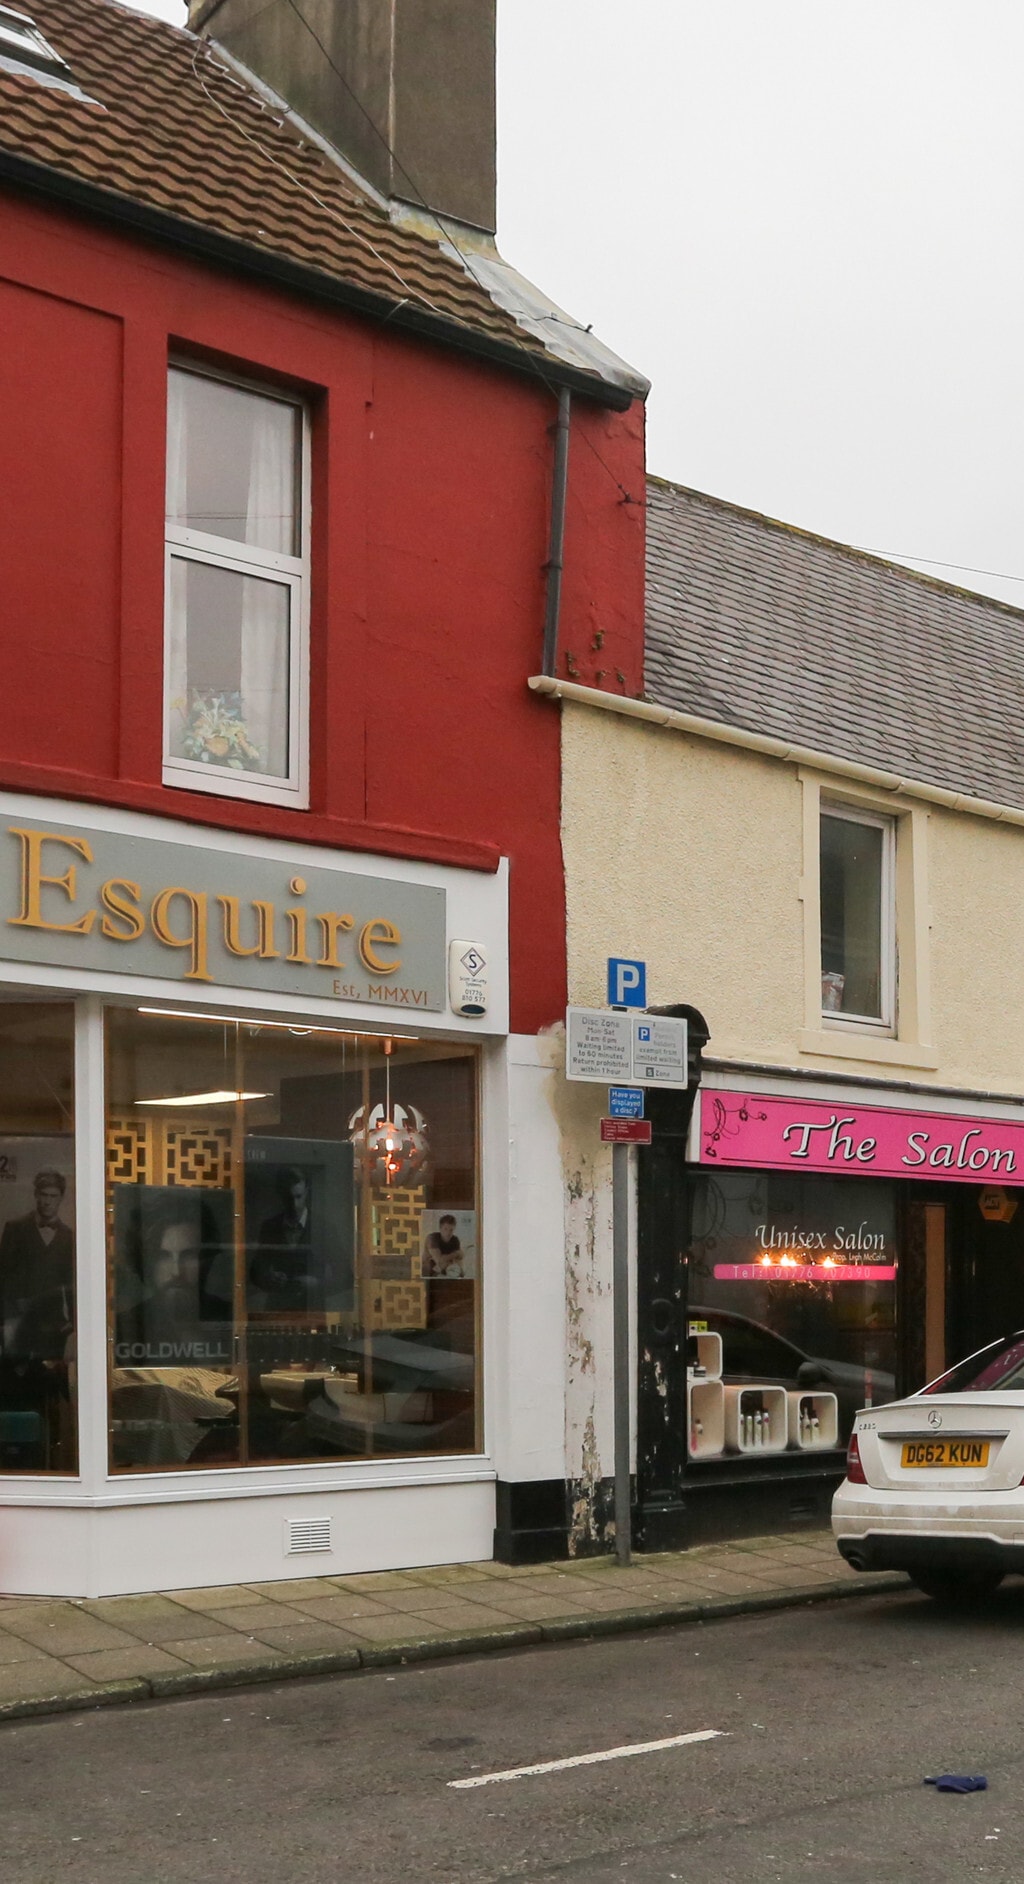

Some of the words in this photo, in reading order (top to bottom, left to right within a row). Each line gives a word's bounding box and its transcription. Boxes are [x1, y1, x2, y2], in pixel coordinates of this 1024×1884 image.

[7, 826, 402, 981] Esquire
[616, 963, 640, 1002] P
[368, 984, 428, 1006] MMXVI
[581, 1016, 599, 1026] Disc
[601, 1019, 620, 1028] Zone
[640, 1028, 649, 1040] P
[577, 1041, 602, 1051] Waiting
[602, 1044, 625, 1053] limited
[572, 1056, 595, 1064] Return
[596, 1060, 629, 1068] prohibited
[598, 1052, 624, 1060] minutes
[655, 1069, 671, 1077] Zone
[611, 1090, 629, 1098] Have
[610, 1098, 641, 1108] displayed
[783, 1115, 876, 1162] The
[901, 1129, 1017, 1173] Salon
[755, 1224, 827, 1250] Unisex
[833, 1221, 886, 1250] Salon
[116, 1341, 229, 1359] GOLDWELL
[906, 1444, 944, 1463] DG62
[948, 1443, 983, 1463] KUN
